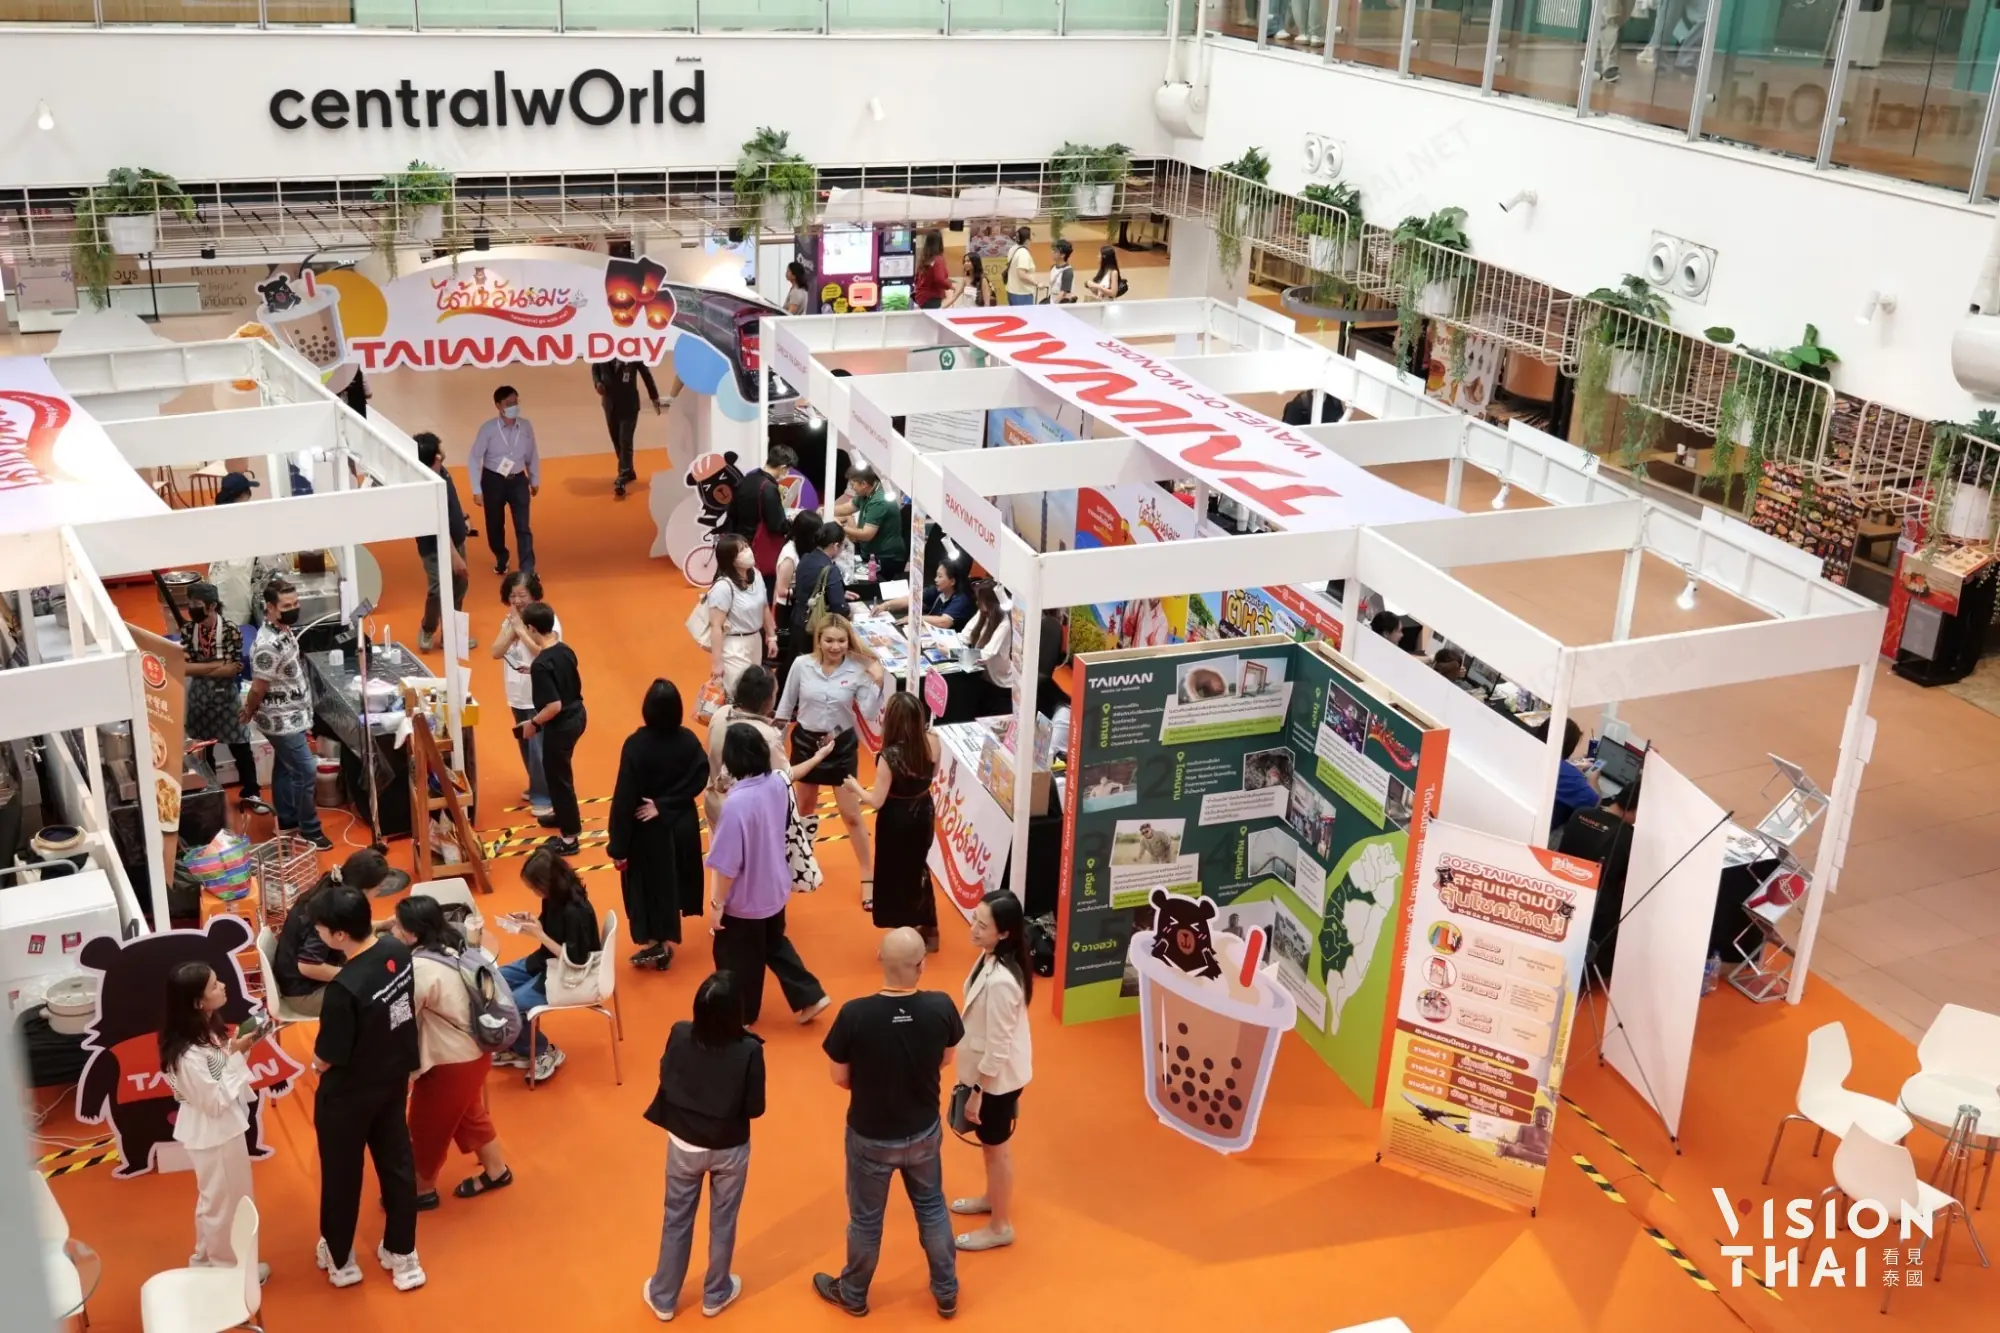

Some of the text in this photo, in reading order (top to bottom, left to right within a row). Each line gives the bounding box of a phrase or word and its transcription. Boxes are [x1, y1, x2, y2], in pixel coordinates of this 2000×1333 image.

[352, 333, 666, 369] TAIWAN Day
[948, 316, 1342, 517] TAIWAN
[1096, 339, 1322, 460] WAVES OF WONDER
[1088, 672, 1154, 689] TAIWAN
[1441, 856, 1481, 874] 2025
[1482, 866, 1543, 890] TAIWAN
[1544, 882, 1573, 901] Day
